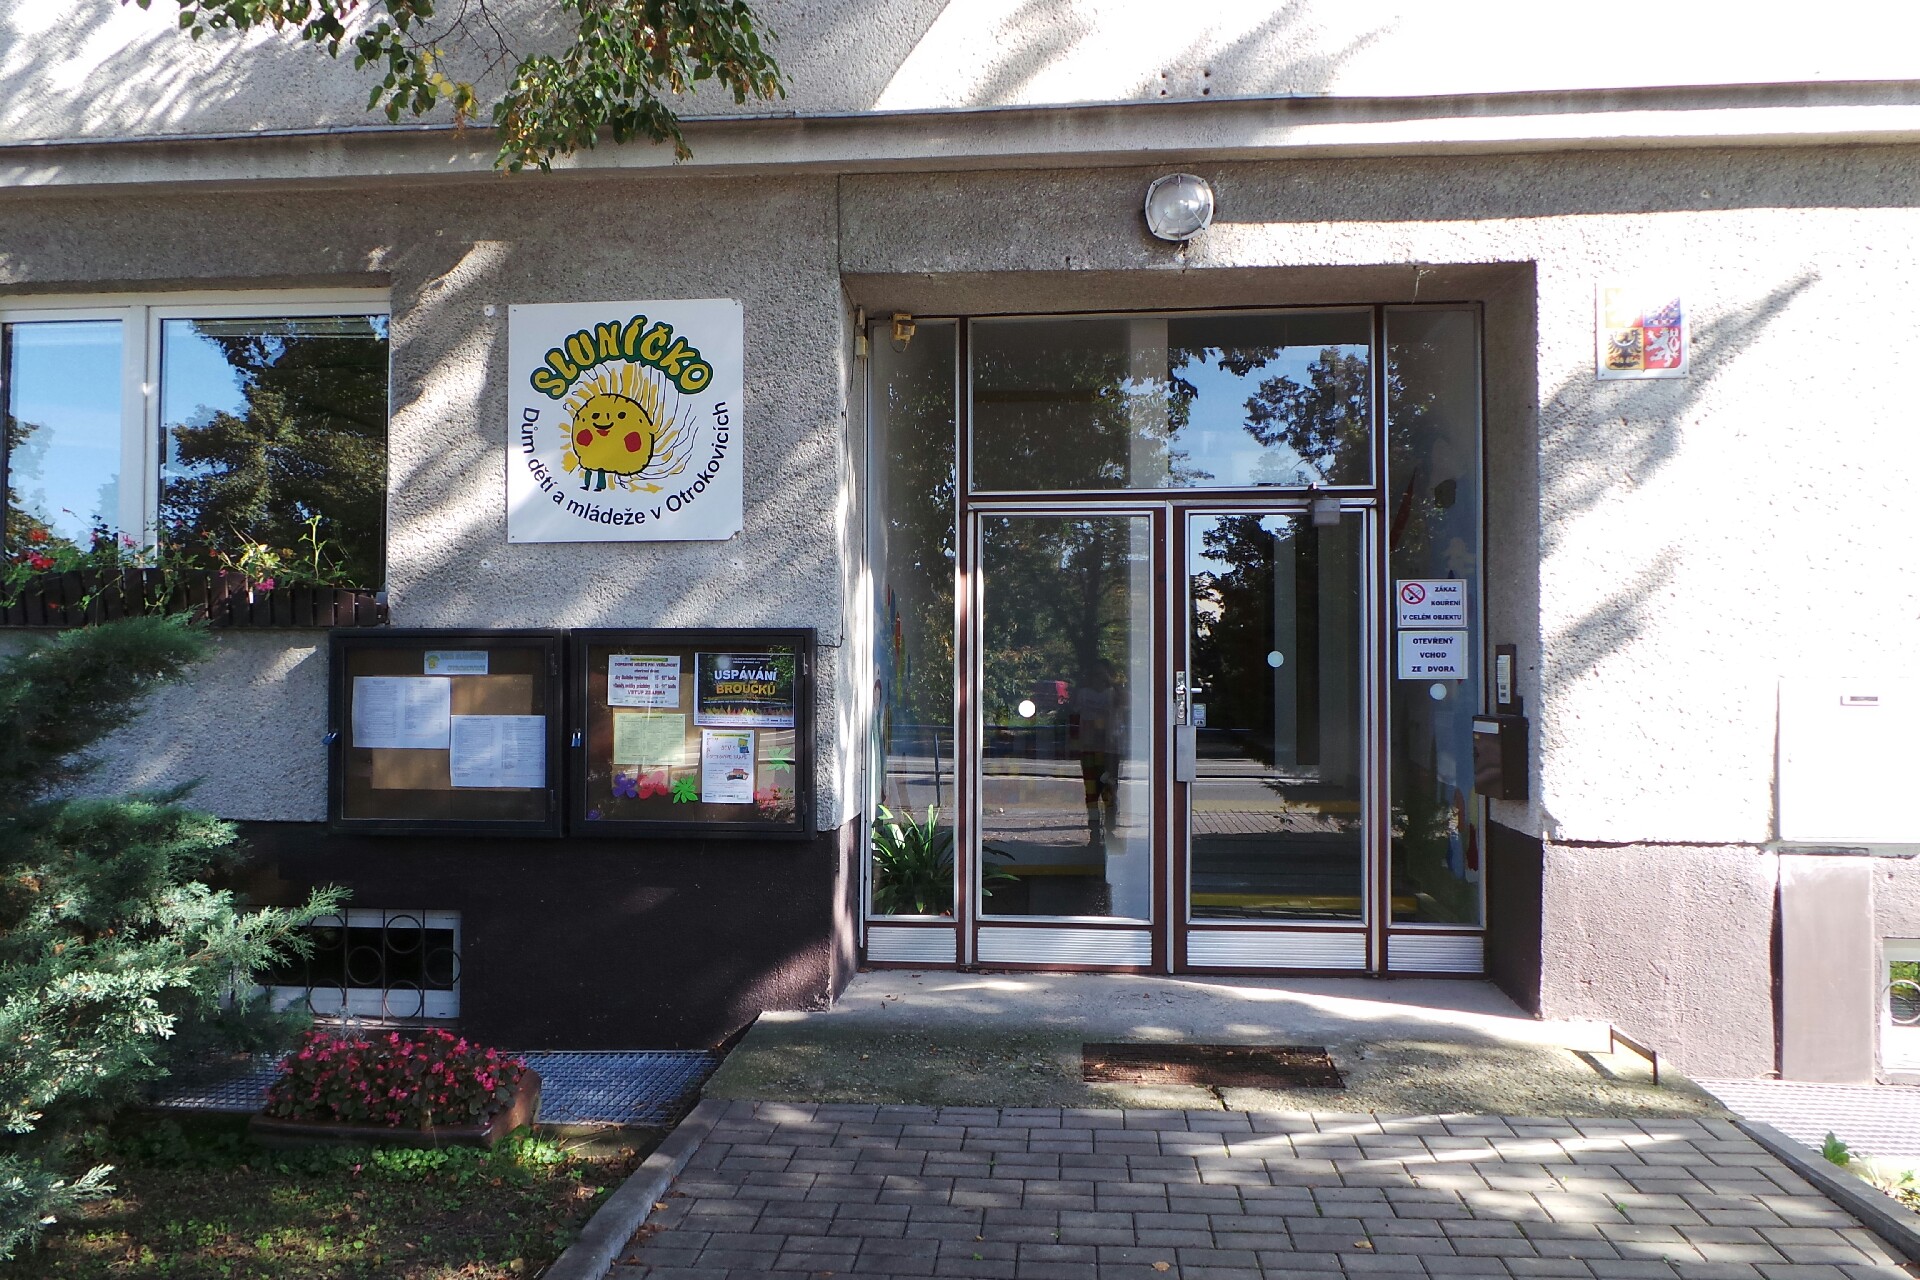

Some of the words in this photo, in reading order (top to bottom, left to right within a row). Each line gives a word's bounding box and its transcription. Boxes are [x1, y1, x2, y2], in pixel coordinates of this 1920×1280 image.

[531, 315, 713, 399] SLUNÍČKO
[521, 407, 541, 454] Dům
[665, 400, 730, 513] Otrokovicích
[527, 458, 559, 493] dětí
[552, 490, 566, 505] a
[565, 499, 646, 526] mládeže
[650, 507, 662, 521] v
[1434, 585, 1457, 593] ZÁKAZ
[1412, 636, 1454, 645] OTEVŘENÝ
[714, 665, 778, 681] USPÁVÁNÍ
[716, 681, 776, 695] BROUČKŮ
